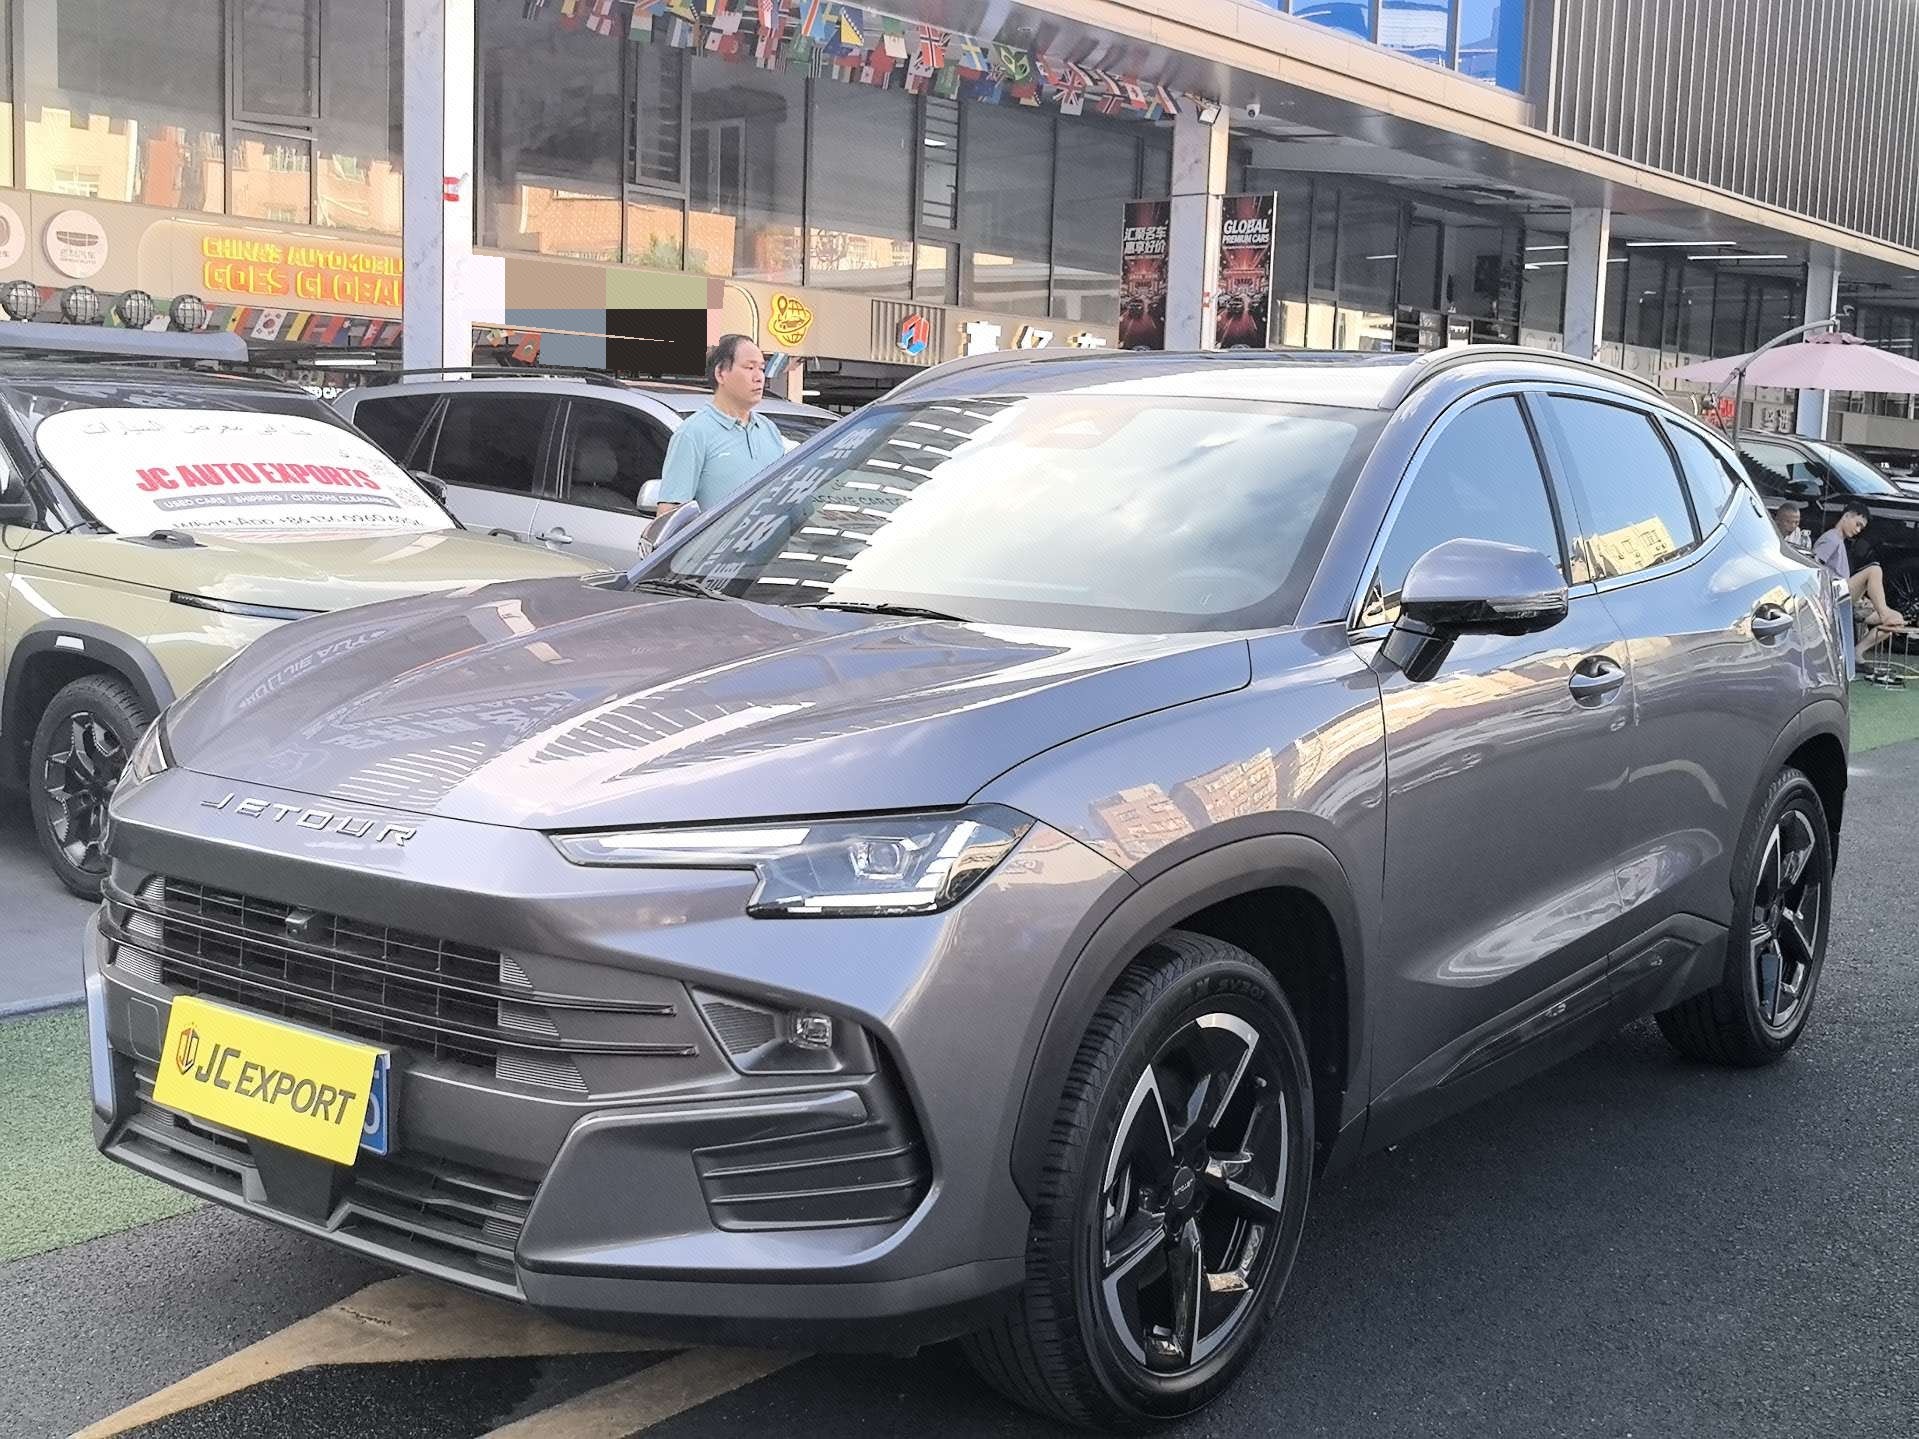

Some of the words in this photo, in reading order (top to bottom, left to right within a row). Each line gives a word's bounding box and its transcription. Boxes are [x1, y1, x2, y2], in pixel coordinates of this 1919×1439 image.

[1223, 234, 1252, 244] PREMIUM
[1252, 233, 1269, 243] CARS
[1224, 219, 1269, 234] GLOBAL
[287, 247, 402, 277] AUTOMOBIL
[203, 260, 289, 295] GOES
[135, 466, 180, 492] JC
[175, 463, 261, 488] AUTO
[253, 463, 381, 490] EXPORTS
[200, 792, 417, 847] JETOUR
[195, 1043, 241, 1090] JC
[234, 1061, 356, 1125] EXPORT
